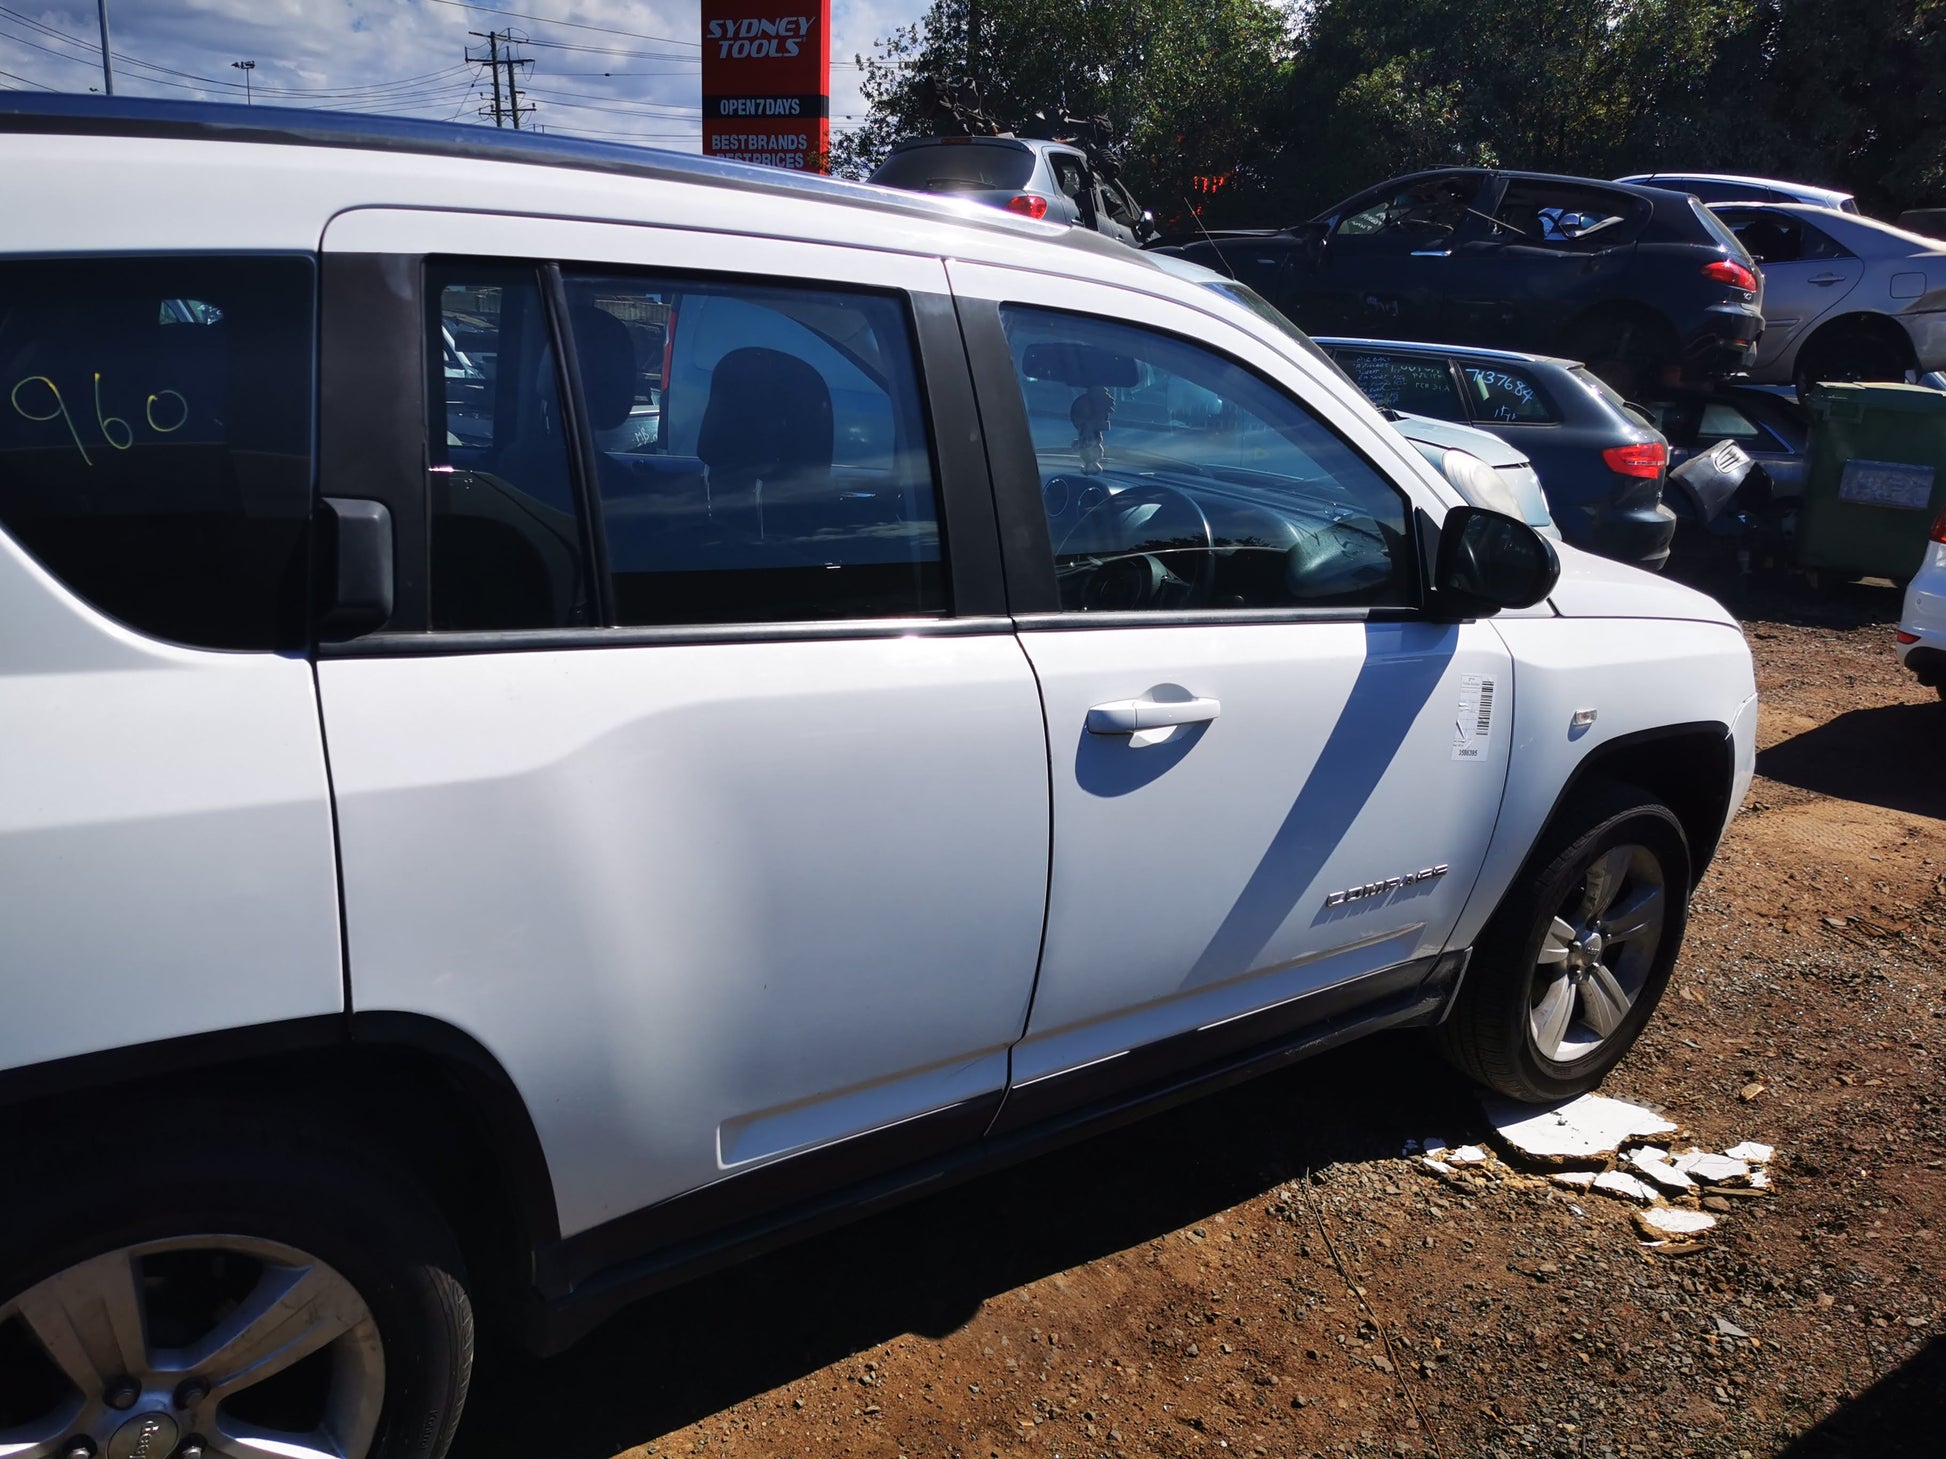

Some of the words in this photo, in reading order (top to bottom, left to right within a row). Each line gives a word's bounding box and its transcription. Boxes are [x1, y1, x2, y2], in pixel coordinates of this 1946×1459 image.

[707, 16, 816, 39] SYDNEY
[719, 38, 803, 59] TOOLS
[11, 372, 188, 466] 960
[1326, 864, 1448, 907] COMPASS
